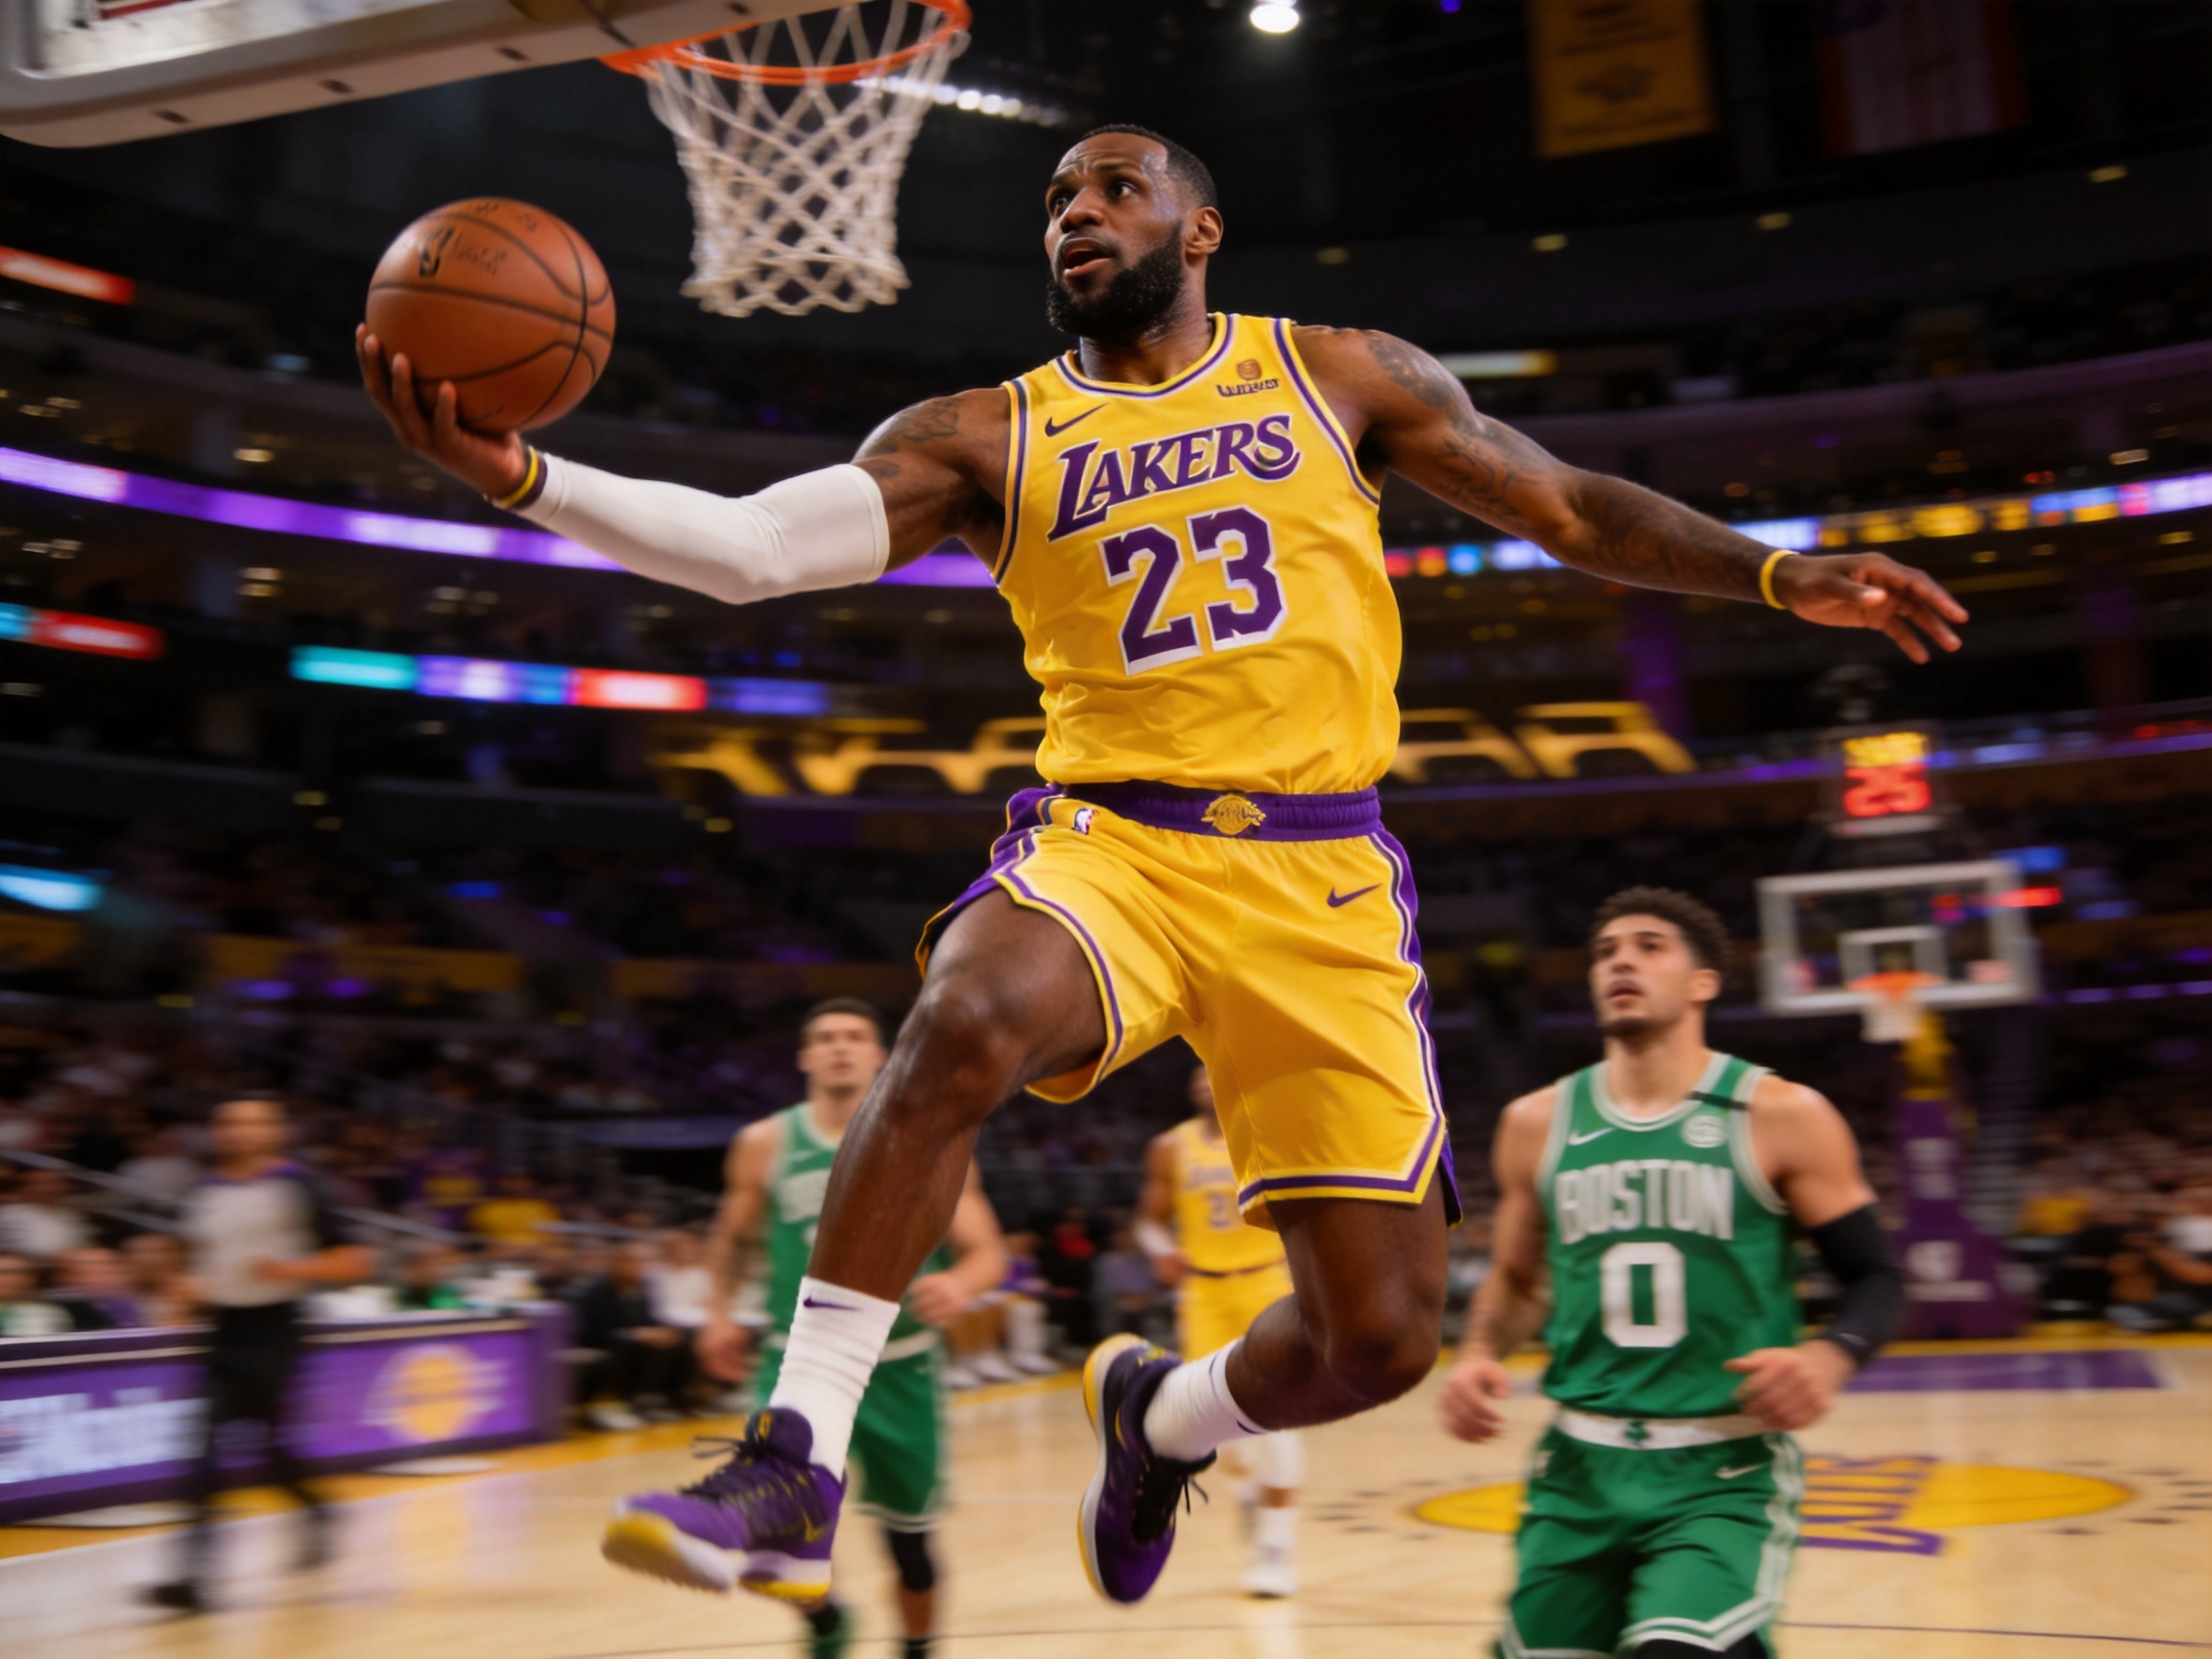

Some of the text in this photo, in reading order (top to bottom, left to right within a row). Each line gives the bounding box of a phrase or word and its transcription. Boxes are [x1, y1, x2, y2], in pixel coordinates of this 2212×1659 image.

[1046, 414, 1301, 543] LAKERS
[1098, 506, 1288, 676] 23
[1554, 1159, 1734, 1244] BOSTON
[1600, 1242, 1688, 1347] 0
